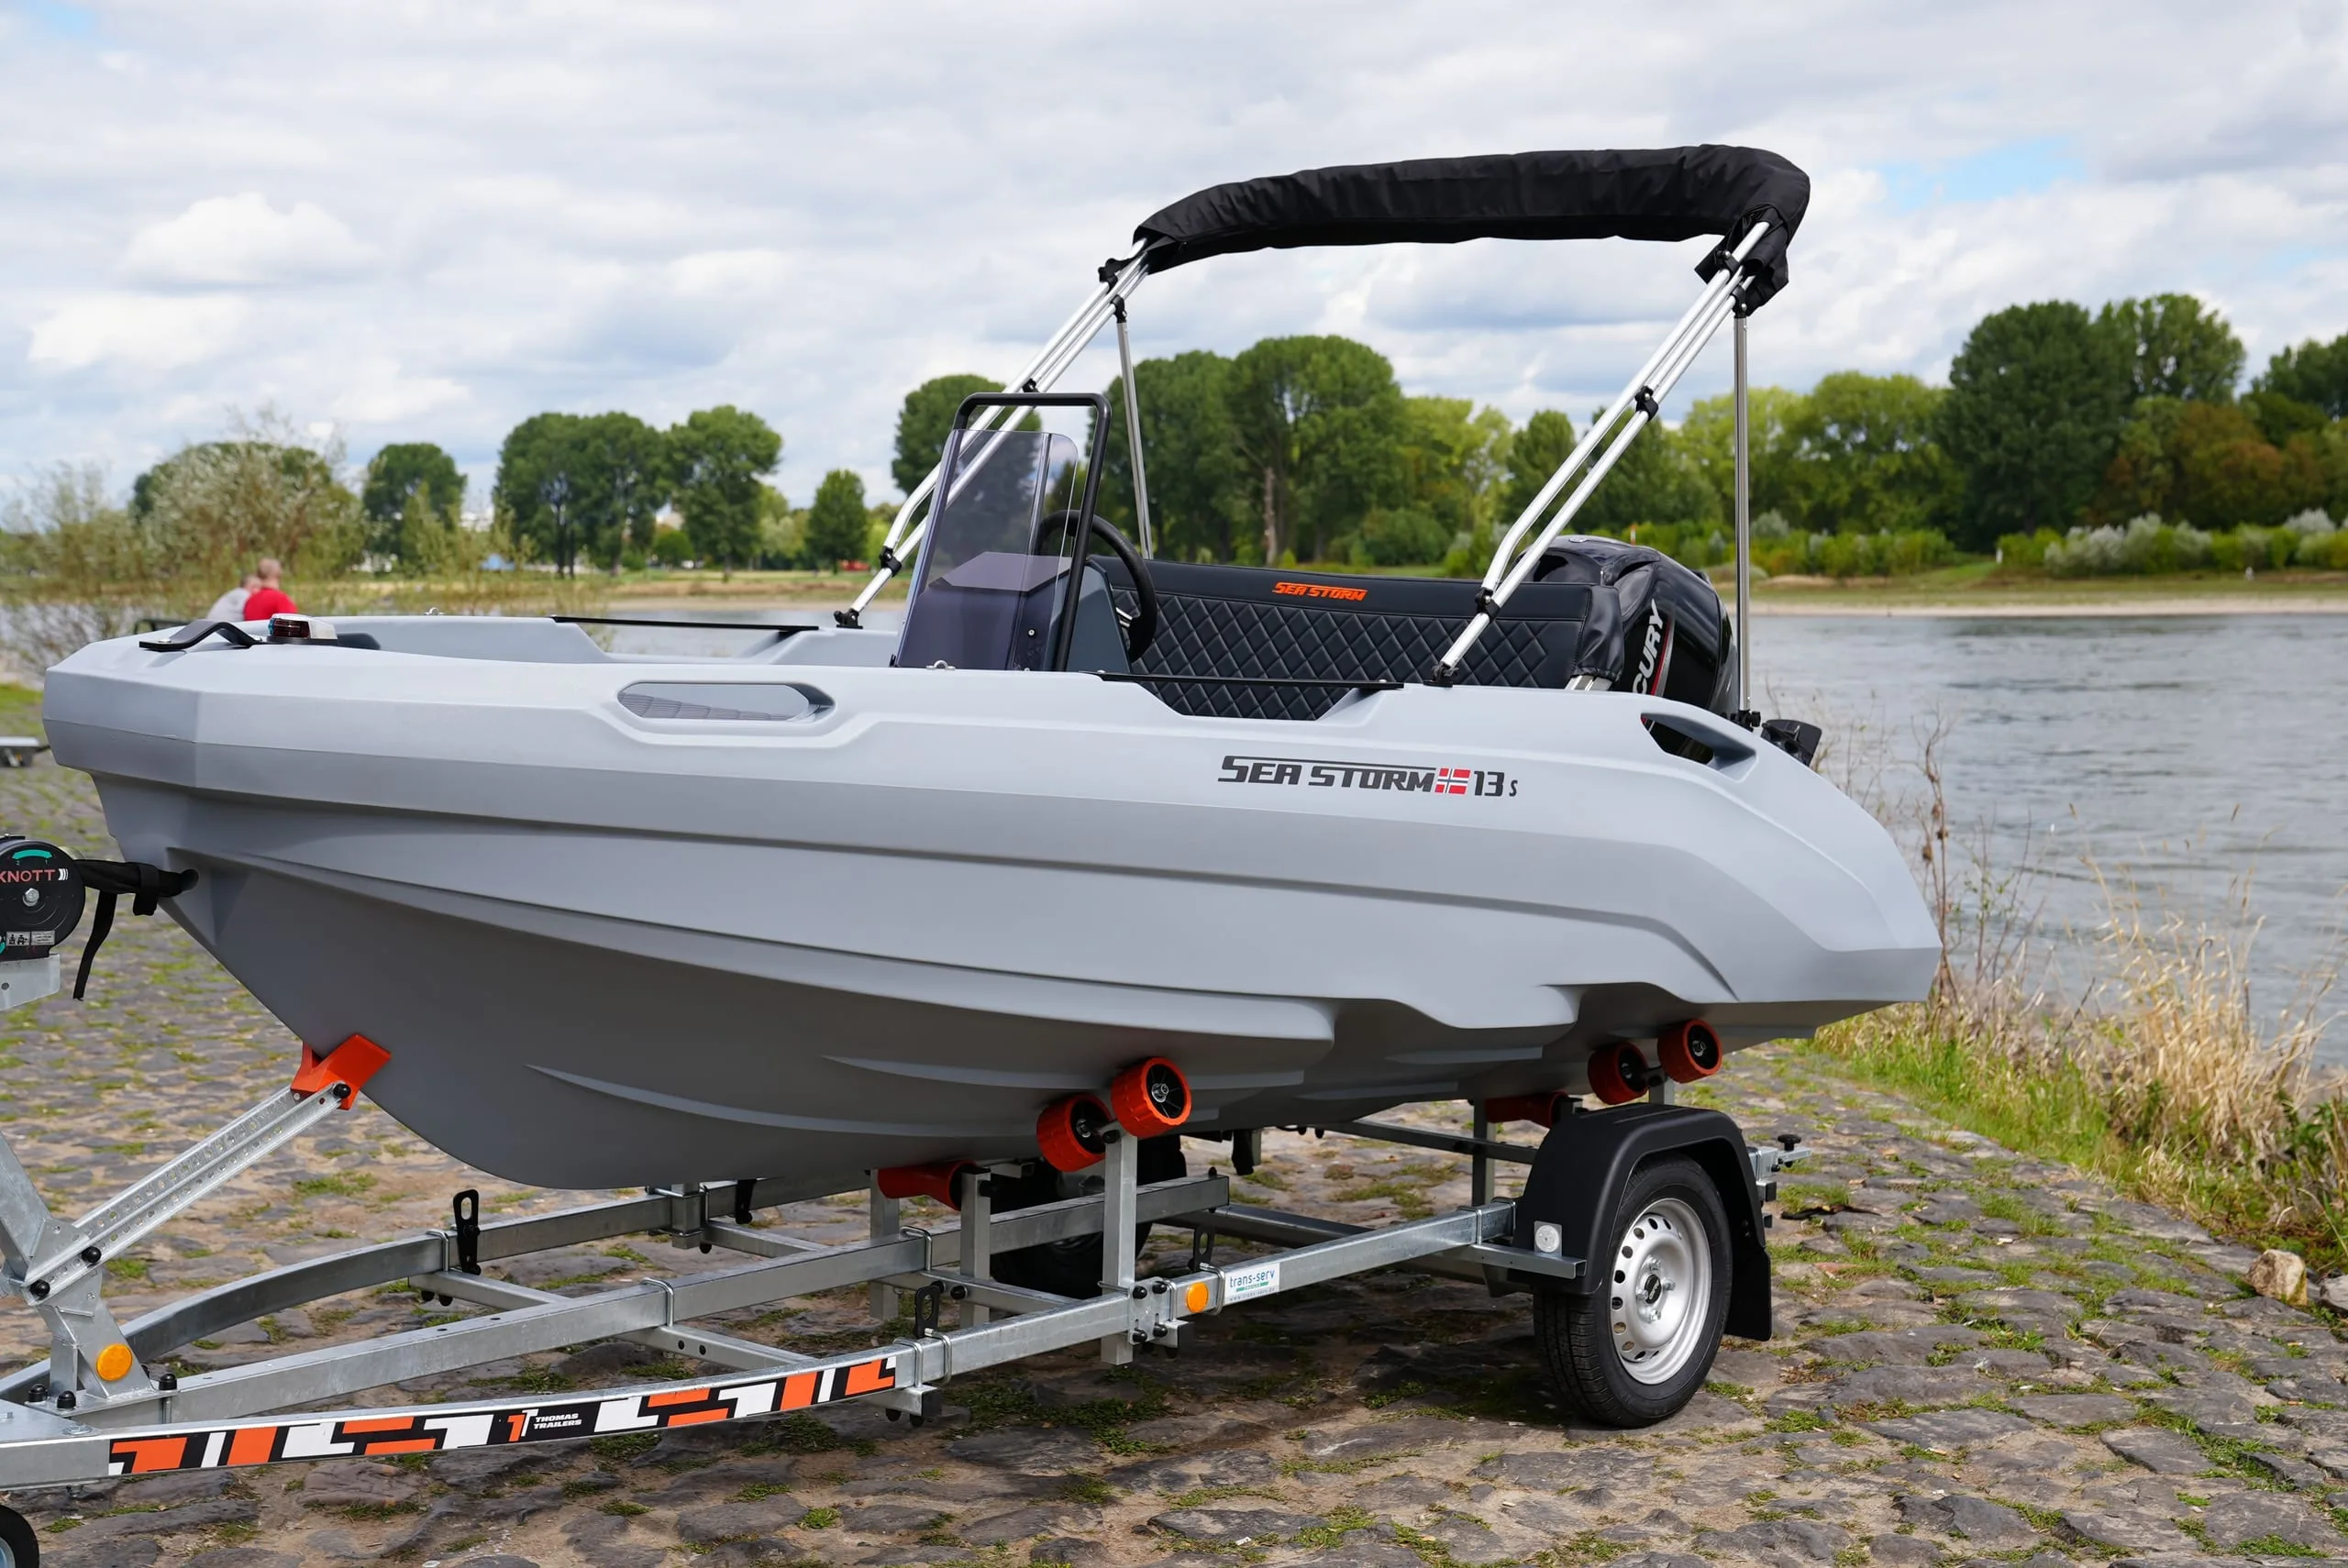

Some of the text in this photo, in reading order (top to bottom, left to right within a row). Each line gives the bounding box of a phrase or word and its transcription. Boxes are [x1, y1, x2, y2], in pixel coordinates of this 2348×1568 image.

[1272, 582, 1368, 602] SEA STORM
[1218, 756, 1302, 786] SEA
[1308, 763, 1436, 793] STORM
[0, 868, 56, 883] KNOTT
[1229, 1269, 1275, 1288] trans-serv
[534, 1419, 581, 1430] TRAILERS
[536, 1413, 580, 1423] THOMAS
